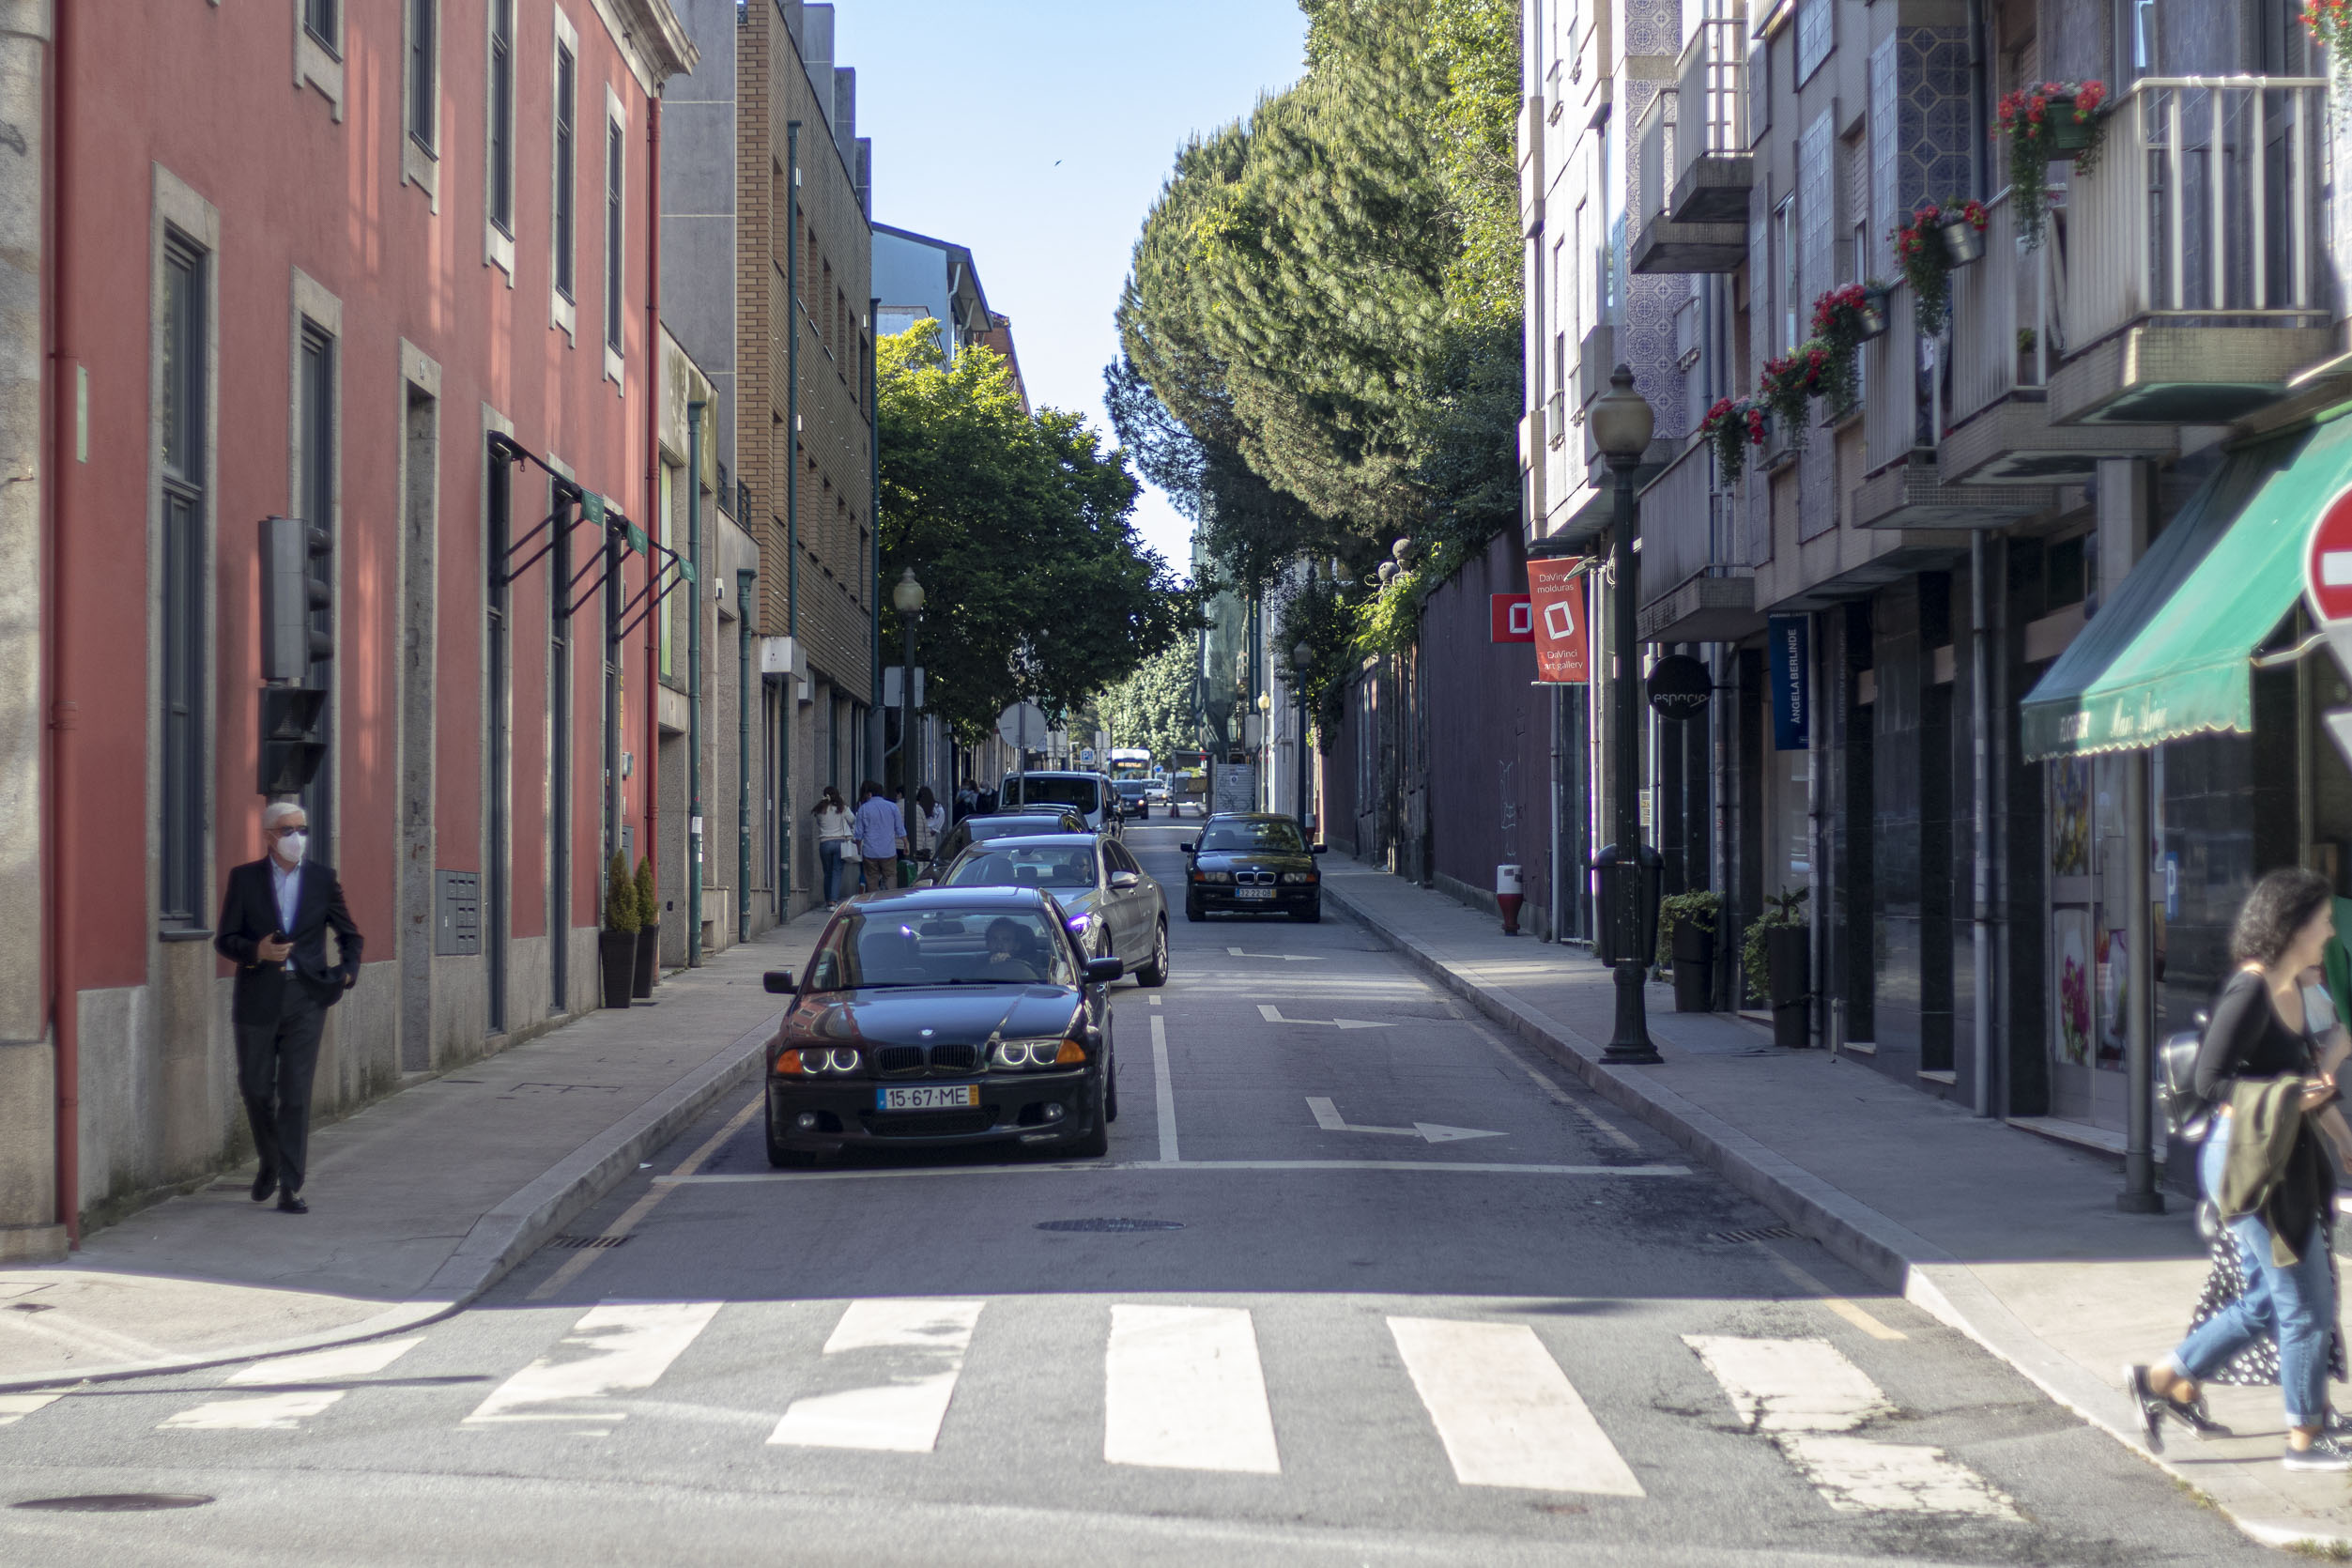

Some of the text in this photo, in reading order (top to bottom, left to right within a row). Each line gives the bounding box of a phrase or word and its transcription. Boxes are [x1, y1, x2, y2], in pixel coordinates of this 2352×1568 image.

[1537, 583, 1575, 593] molduras
[1546, 649, 1577, 659] DaVinci
[1788, 629, 1799, 680] BERLINDE
[1557, 660, 1583, 670] gallery
